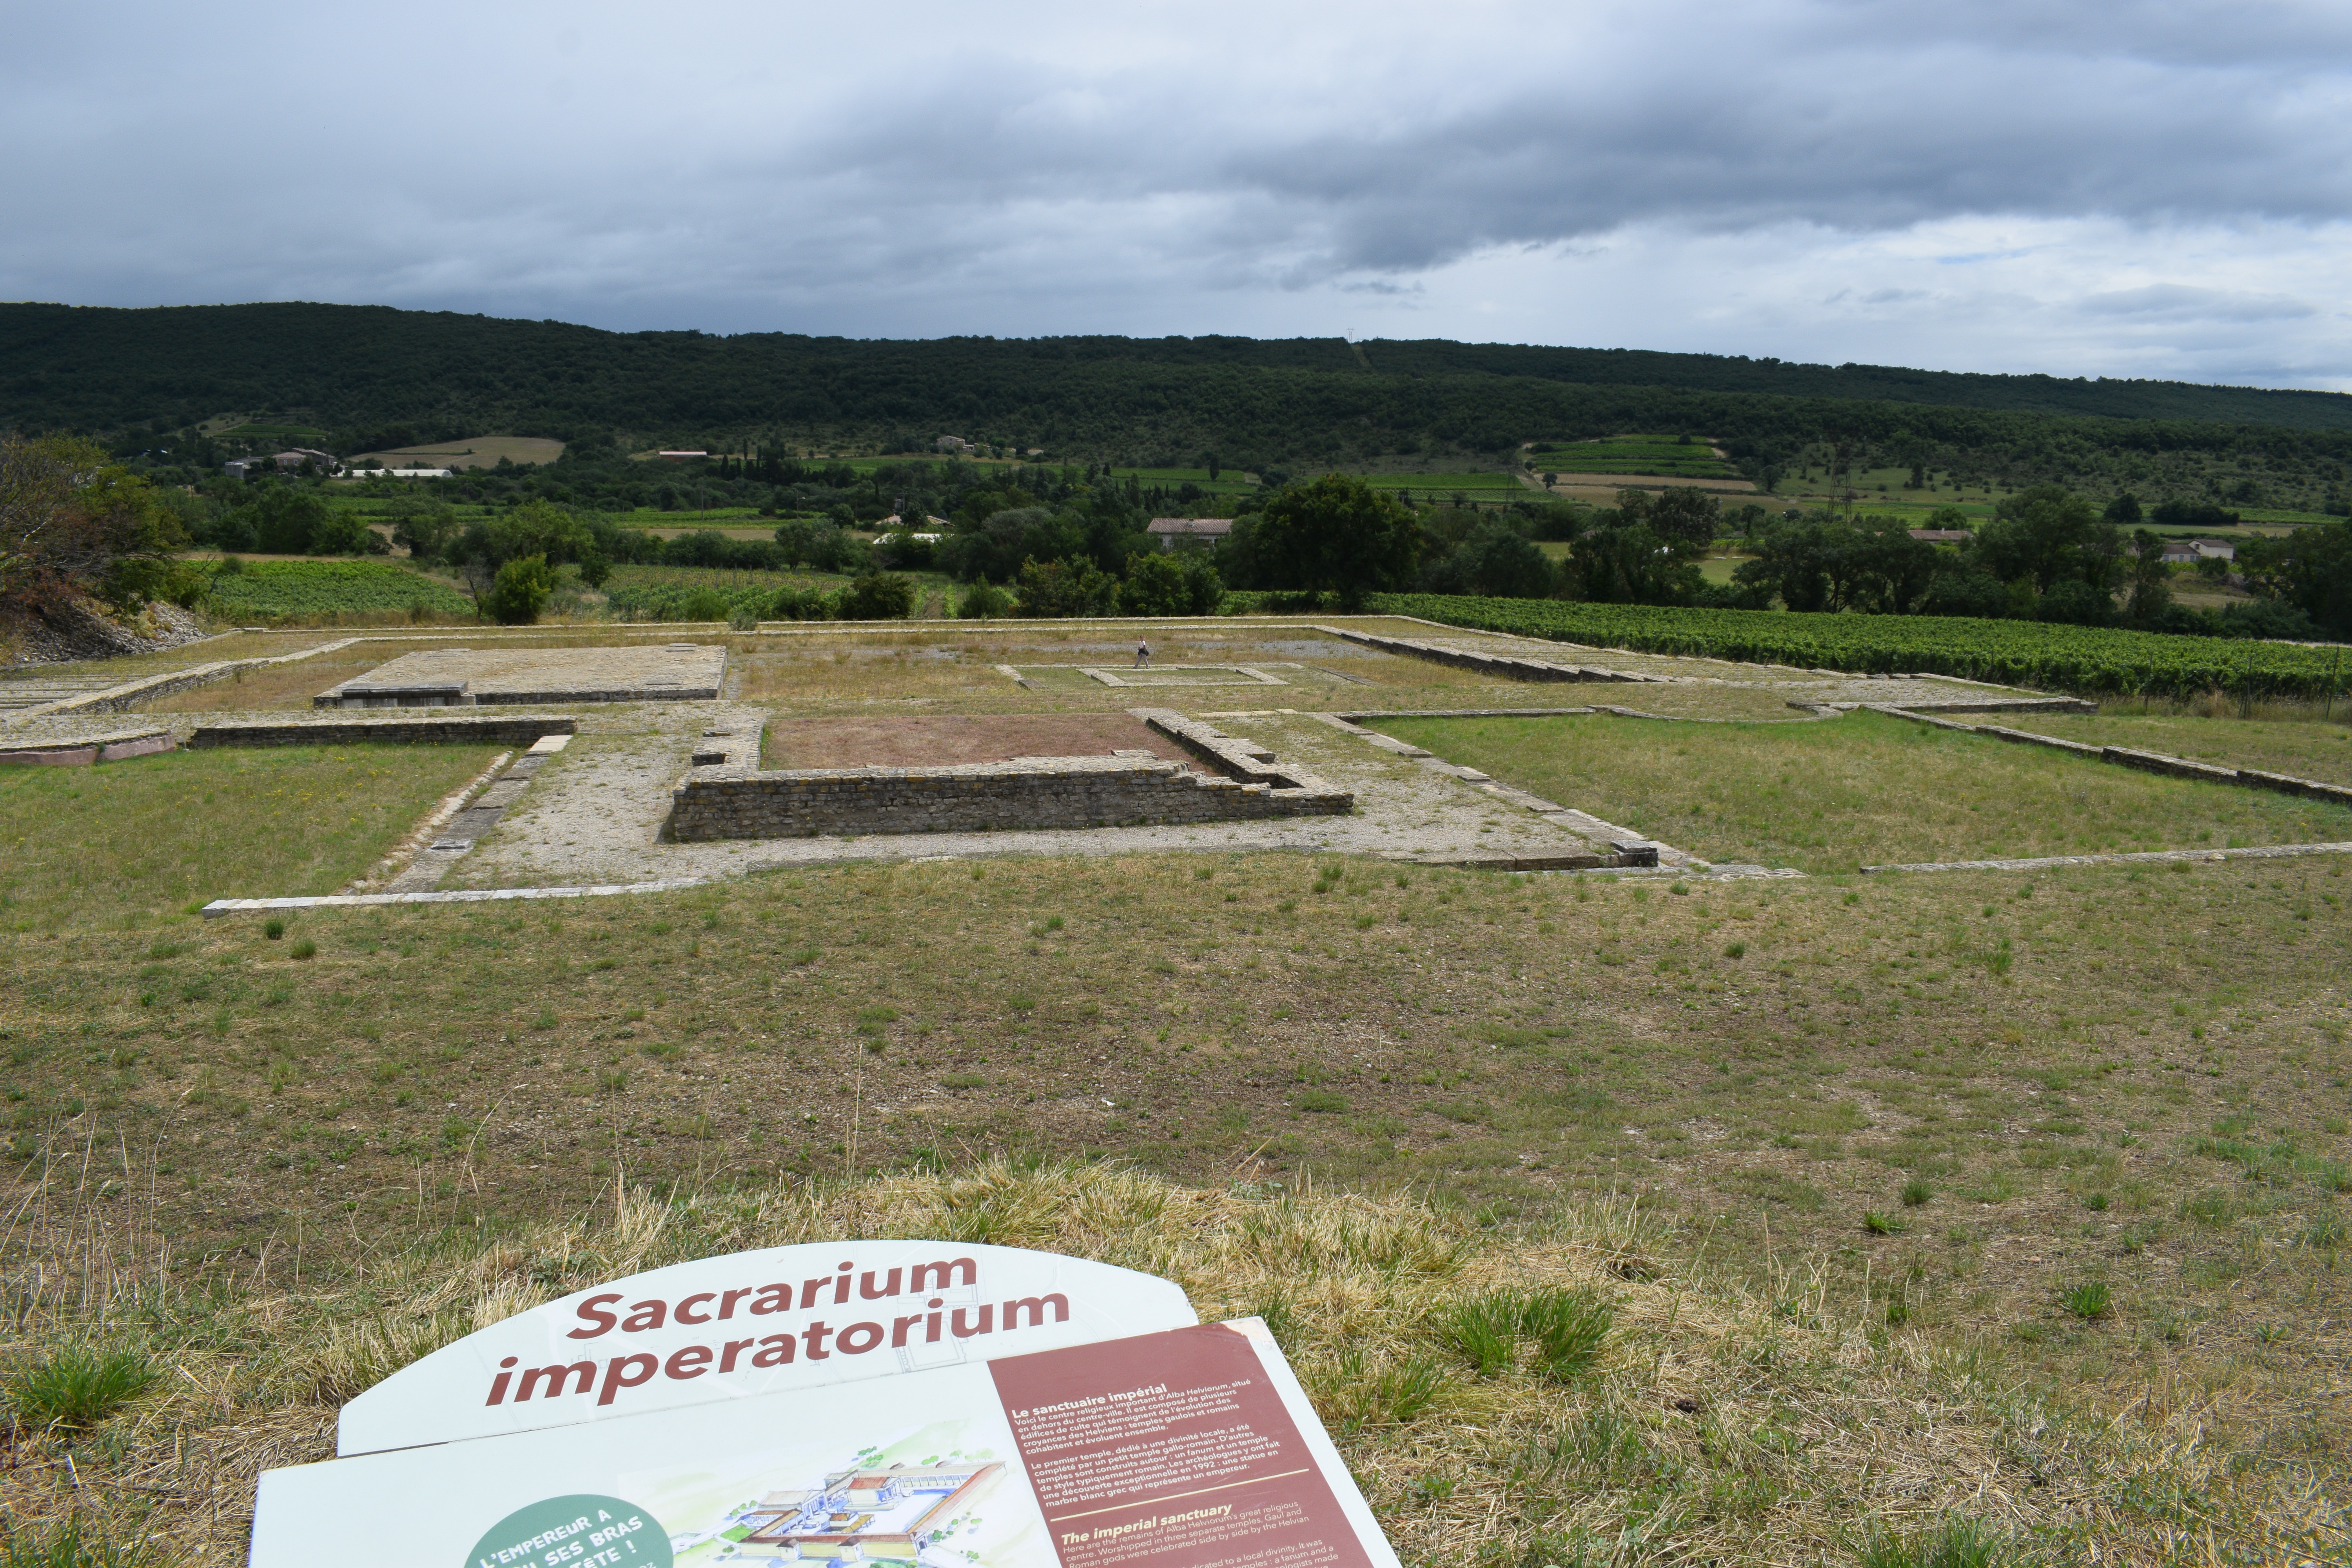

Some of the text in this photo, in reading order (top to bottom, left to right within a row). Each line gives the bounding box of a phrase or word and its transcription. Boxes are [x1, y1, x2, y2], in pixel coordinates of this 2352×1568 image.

[566, 1258, 976, 1339] Sacrarium
[485, 1292, 1070, 1406] imperatorium
[1011, 1383, 1167, 1419] Le sanctuaire impérial
[1014, 1417, 1036, 1425] Voici
[1049, 1412, 1075, 1420] centre
[1077, 1405, 1114, 1415] religieux
[1115, 1397, 1157, 1408] important
[1158, 1392, 1185, 1400] d'Alba
[1187, 1384, 1230, 1396] Helviorum,
[1232, 1379, 1251, 1387] situé
[1021, 1430, 1054, 1440] édifices
[1093, 1419, 1106, 1430] qui
[1107, 1411, 1157, 1424] témoignent
[1159, 1407, 1169, 1415] de
[1171, 1401, 1214, 1412] l'évolution
[1031, 1421, 1061, 1430] dehors
[1076, 1410, 1125, 1423] centre-ville.
[1148, 1398, 1185, 1410] composé
[1200, 1390, 1237, 1401] plusieurs
[1024, 1436, 1067, 1447] croyances
[1085, 1426, 1122, 1436] Helviens
[1129, 1418, 1163, 1428] temples
[1165, 1412, 1195, 1423] gaulois
[1207, 1404, 1240, 1414] romains
[1026, 1441, 1073, 1454] cohabitent
[1085, 1432, 1123, 1444] évoluent
[1125, 1423, 1169, 1437] ensemble.
[1034, 1464, 1076, 1476] complété
[1078, 1462, 1092, 1470] par
[1108, 1454, 1129, 1465] petit
[1130, 1448, 1160, 1459] temple
[1163, 1438, 1218, 1454] gallo-romain.
[1219, 1432, 1254, 1442] D'autres
[1036, 1474, 1073, 1484] temples
[1075, 1469, 1094, 1477] sont
[1096, 1461, 1138, 1473] construits
[1140, 1455, 1168, 1465] autour
[1187, 1447, 1214, 1455] fanum
[1238, 1436, 1268, 1446] temple
[1044, 1456, 1078, 1469] premier
[1080, 1450, 1114, 1460] temple,
[1116, 1444, 1140, 1454] dédié
[1167, 1433, 1198, 1444] divinité
[1200, 1428, 1228, 1438] locale,
[1054, 1481, 1074, 1489] style
[1076, 1470, 1133, 1486] typiquement
[1135, 1464, 1167, 1474] romain.
[1185, 1449, 1242, 1464] archéologues
[1046, 1497, 1078, 1507] marbre
[1080, 1492, 1105, 1501] blanc
[1107, 1488, 1127, 1497] grec
[1129, 1483, 1143, 1492] qui
[1145, 1475, 1191, 1488] représente
[1206, 1464, 1250, 1476] empereur.
[1062, 1483, 1112, 1495] découverte
[1114, 1469, 1178, 1486] exceptionnelle
[1192, 1461, 1215, 1470] 1992
[1240, 1453, 1265, 1461] statue
[598, 1509, 612, 1522] A
[1061, 1504, 1232, 1545] The imperial sanctuary
[1066, 1552, 1096, 1562] centre.
[1098, 1539, 1152, 1555] Worshipped
[1164, 1534, 1186, 1542] three
[1189, 1526, 1225, 1537] separate
[1227, 1518, 1263, 1529] temples,
[1265, 1511, 1284, 1521] Gaul
[1287, 1507, 1302, 1517] and
[1120, 1532, 1153, 1542] remains
[1155, 1527, 1163, 1535] of
[1188, 1513, 1238, 1528] Helviorum's
[1240, 1509, 1261, 1519] great
[1263, 1502, 1298, 1513] religious
[544, 1516, 643, 1566] SES BRAS
[1069, 1560, 1100, 1568] Roman
[1103, 1553, 1125, 1565] gods
[1127, 1550, 1148, 1558] were
[1151, 1538, 1196, 1553] celebrated
[1199, 1535, 1216, 1544] side
[1231, 1528, 1249, 1537] side
[1278, 1517, 1309, 1527] Helvian
[1243, 1550, 1263, 1561] local
[1266, 1546, 1297, 1556] divinity.
[1281, 1552, 1308, 1561] fanum
[1311, 1546, 1326, 1555] and
[1314, 1553, 1338, 1563] made
